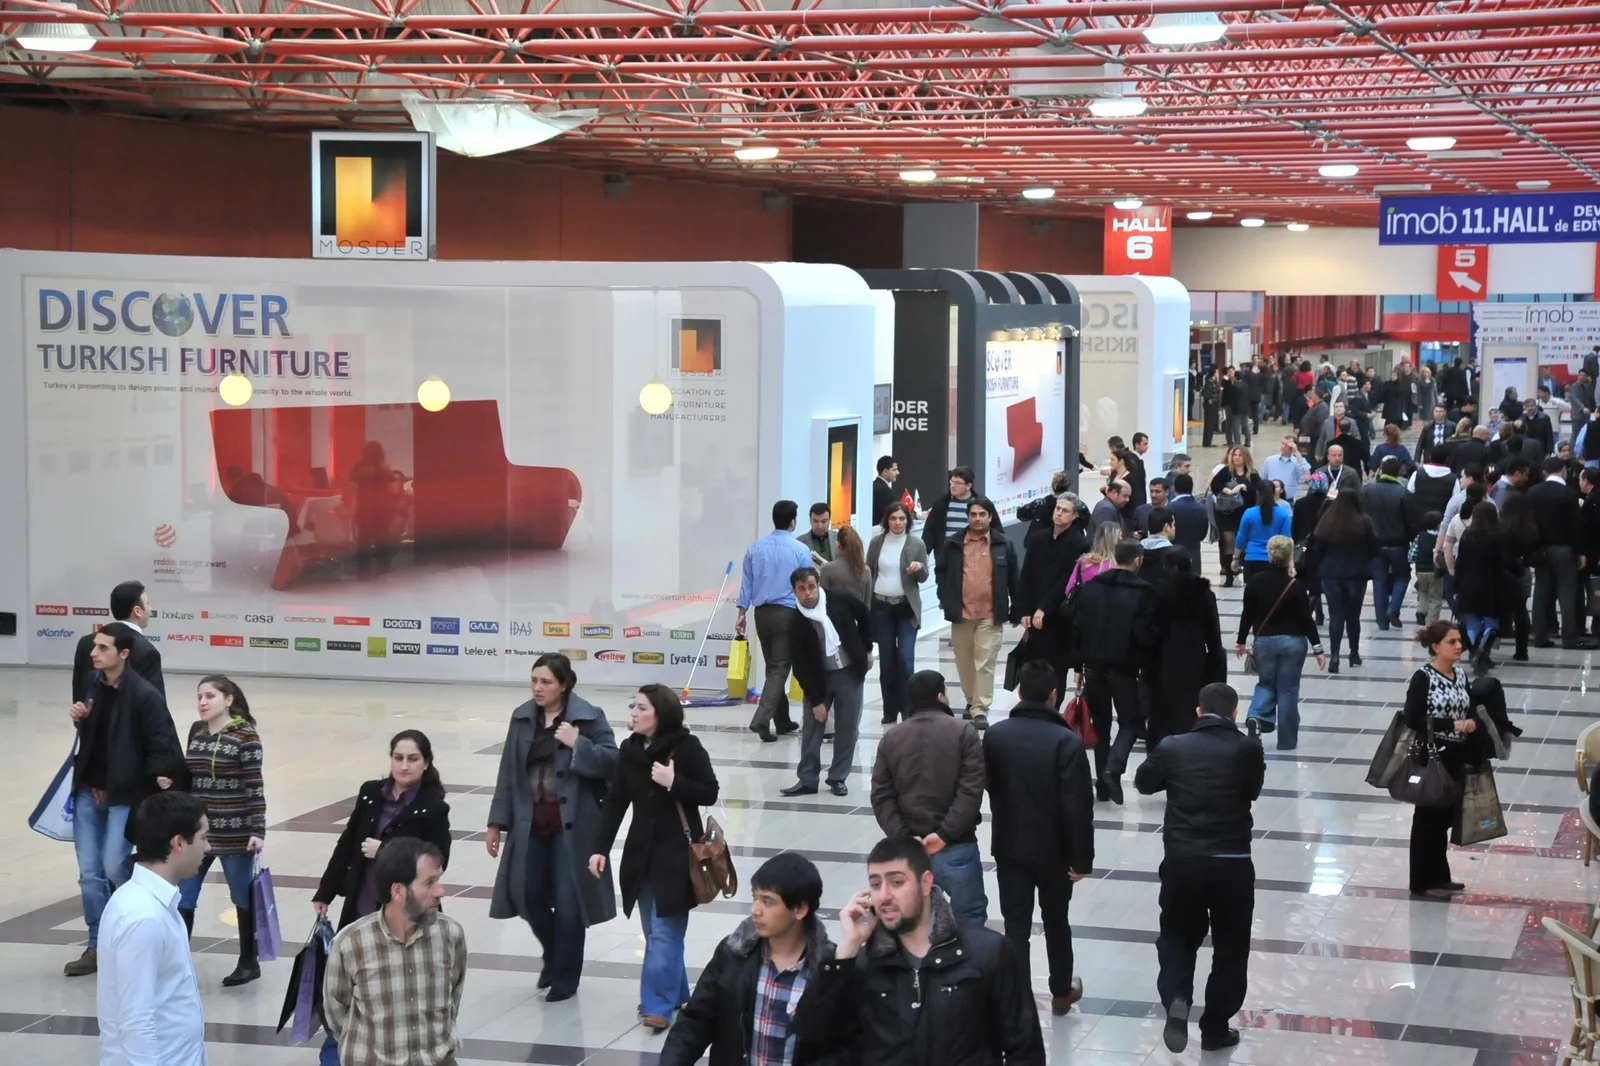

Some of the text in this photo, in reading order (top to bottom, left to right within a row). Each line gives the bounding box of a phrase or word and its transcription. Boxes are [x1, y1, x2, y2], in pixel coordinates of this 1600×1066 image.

[1112, 218, 1168, 232] HALL
[1386, 206, 1458, 235] imob
[1554, 219, 1569, 232] de
[319, 239, 424, 256] MOSDER
[1126, 235, 1154, 260] 6
[1454, 249, 1476, 267] 5
[38, 288, 293, 338] DISCOVER
[1525, 304, 1574, 324] imob
[36, 343, 351, 378] TURKISH FURNITURE
[43, 381, 68, 390] Turkey
[77, 383, 116, 392] presenting
[118, 383, 126, 391] its
[128, 384, 152, 392] design
[154, 385, 177, 393] power
[179, 384, 193, 392] and
[194, 385, 220, 393] manuf
[291, 388, 303, 396] the
[305, 388, 328, 397] whole
[329, 389, 353, 397] world.
[714, 389, 726, 397] OF
[677, 401, 727, 410] FURNITURE
[894, 400, 929, 414] DER
[649, 413, 727, 422] MANUFACTURERS
[244, 613, 274, 624] casa
[470, 621, 498, 631] GALA
[464, 646, 498, 657] teleset
